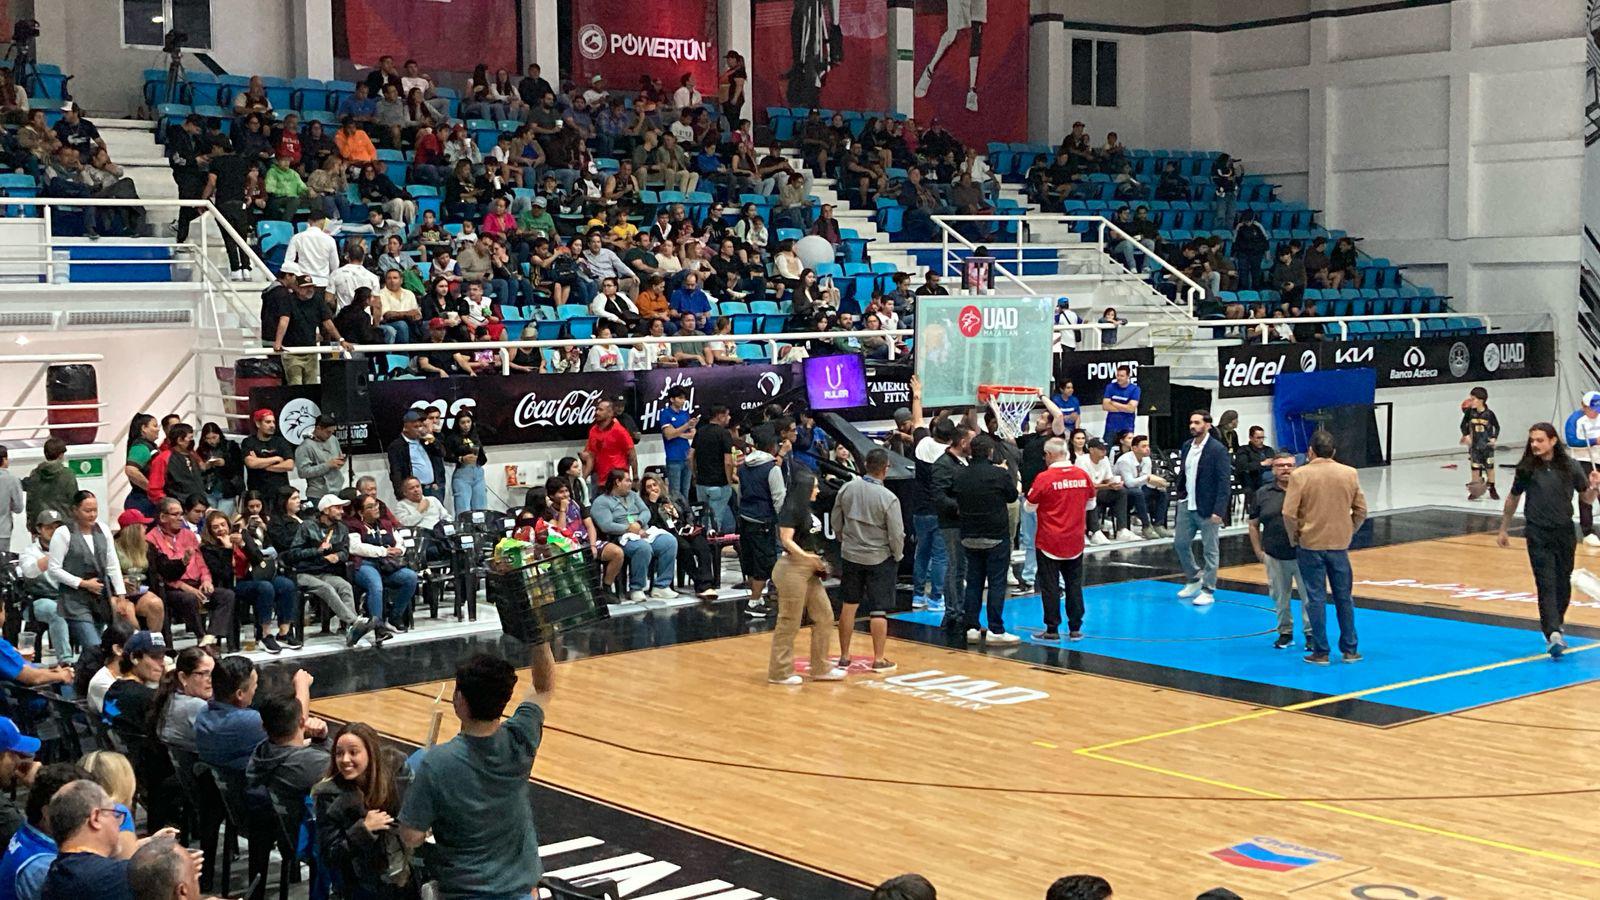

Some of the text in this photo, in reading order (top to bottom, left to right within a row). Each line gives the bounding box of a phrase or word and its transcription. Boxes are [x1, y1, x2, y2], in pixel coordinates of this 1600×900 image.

[983, 307, 1018, 330] UAD
[1500, 343, 1525, 363] UAD
[1223, 355, 1286, 387] telcel
[1390, 368, 1438, 379] Banco Azteca
[884, 669, 1050, 704] UAD
